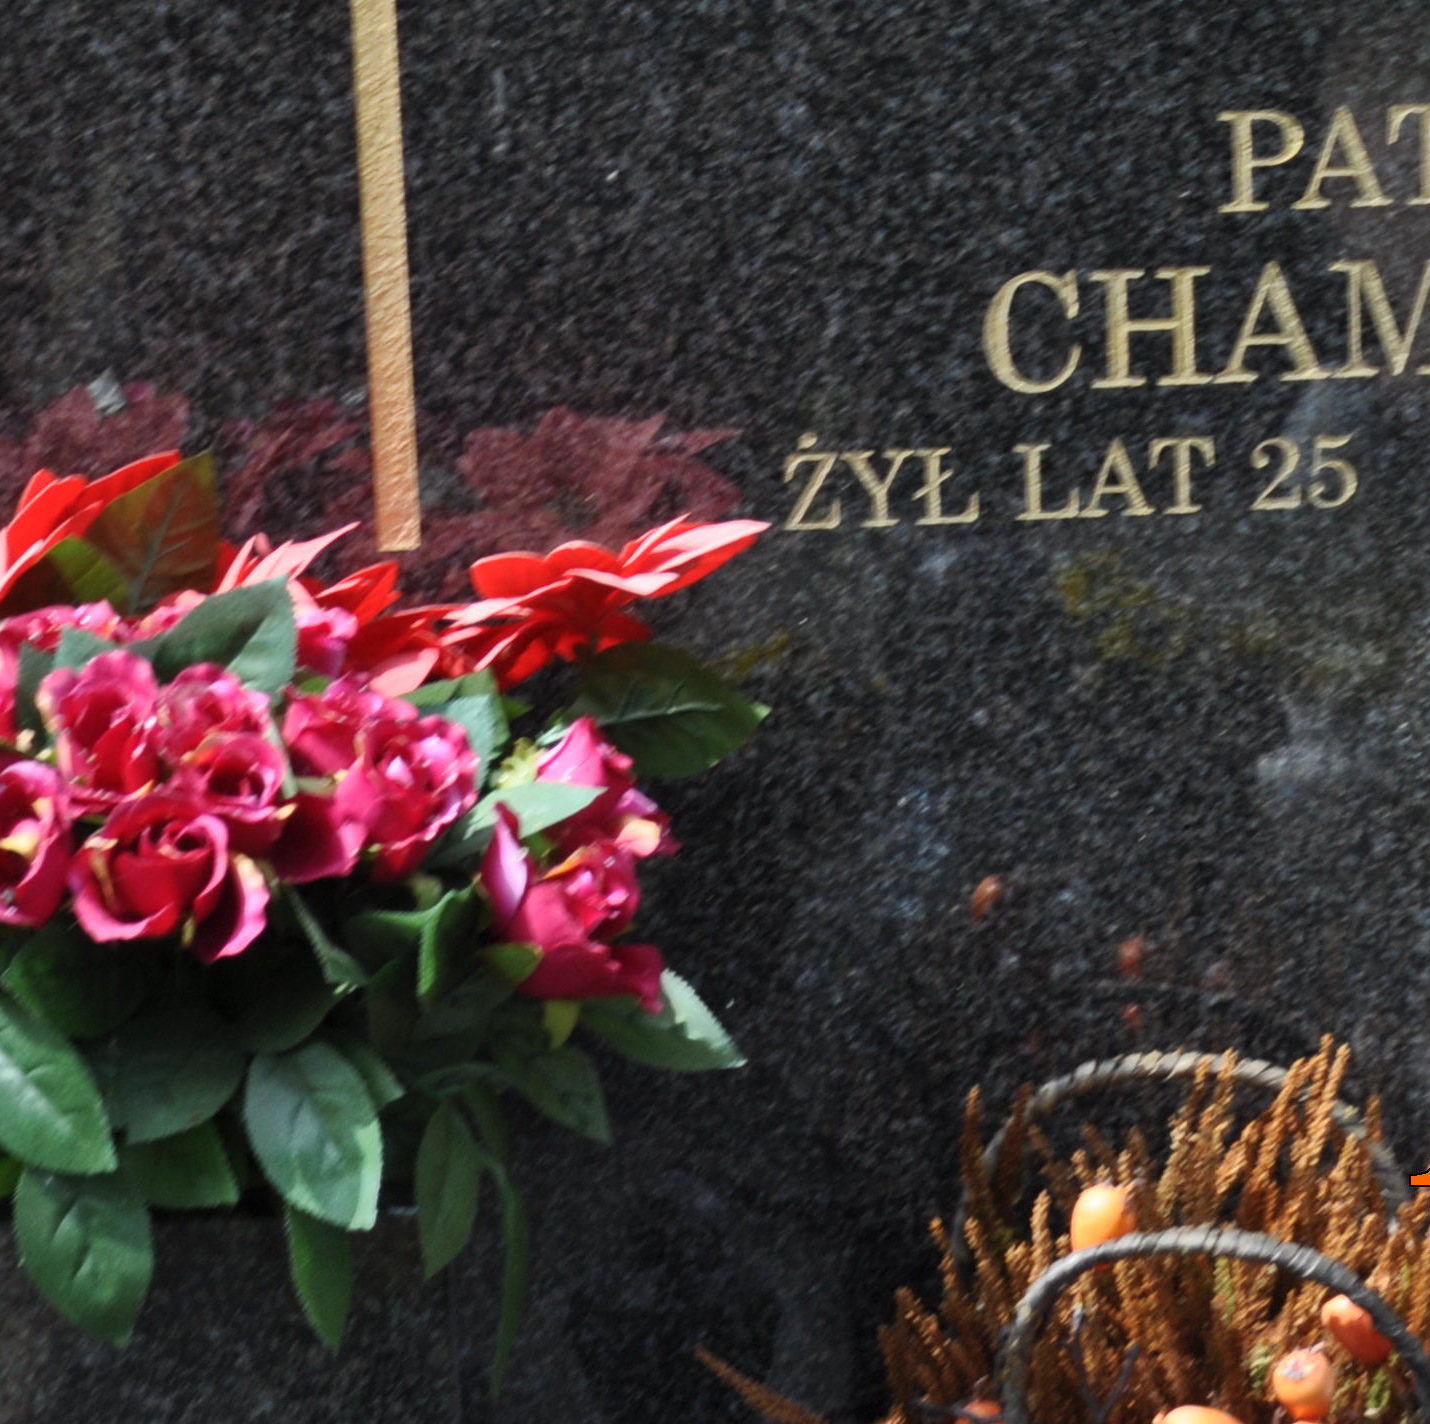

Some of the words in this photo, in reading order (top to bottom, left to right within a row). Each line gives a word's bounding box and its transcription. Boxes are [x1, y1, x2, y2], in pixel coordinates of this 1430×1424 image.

[782, 432, 983, 532] ŻYŁ
[1015, 436, 1217, 523] LAT
[1249, 433, 1360, 512] 25
